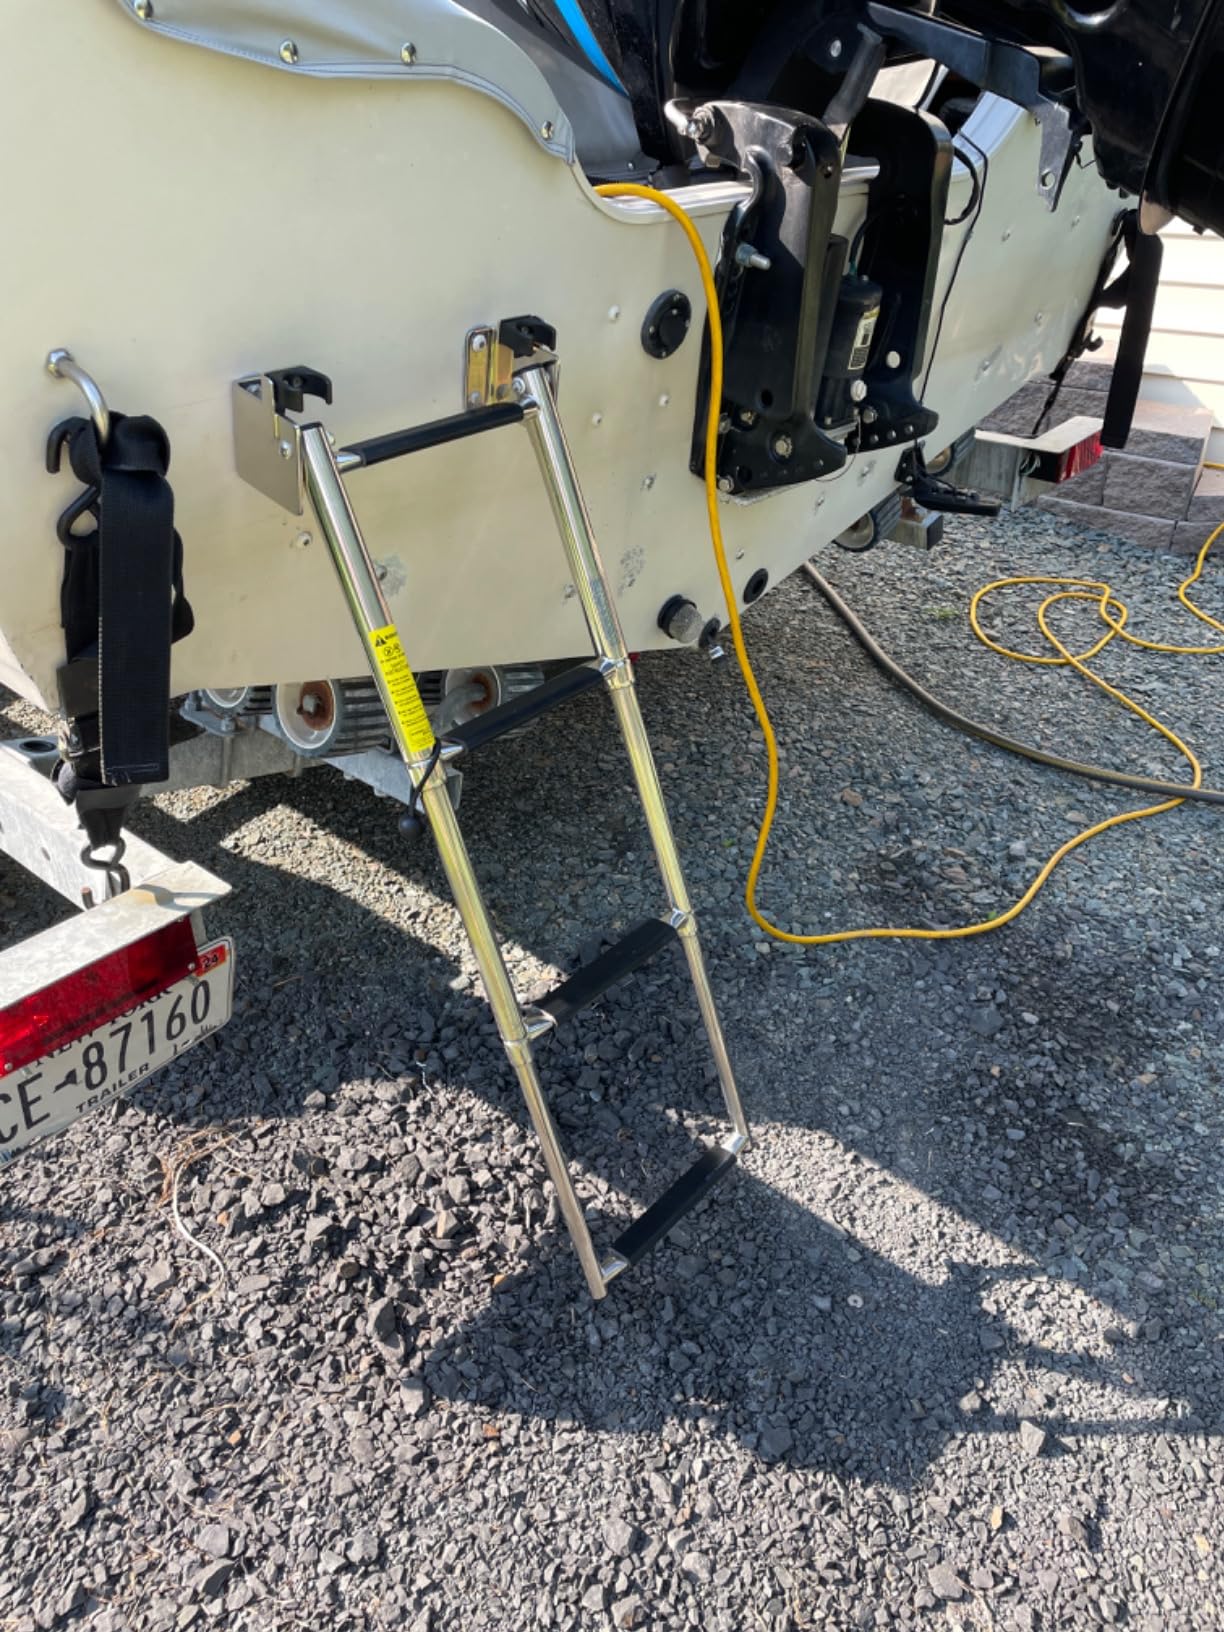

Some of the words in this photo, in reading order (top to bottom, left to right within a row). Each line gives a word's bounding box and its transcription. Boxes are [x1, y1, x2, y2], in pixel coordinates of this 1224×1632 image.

[203, 954, 219, 968] 24
[82, 979, 210, 1091] 87160
[76, 1062, 149, 1113] TRAILER
